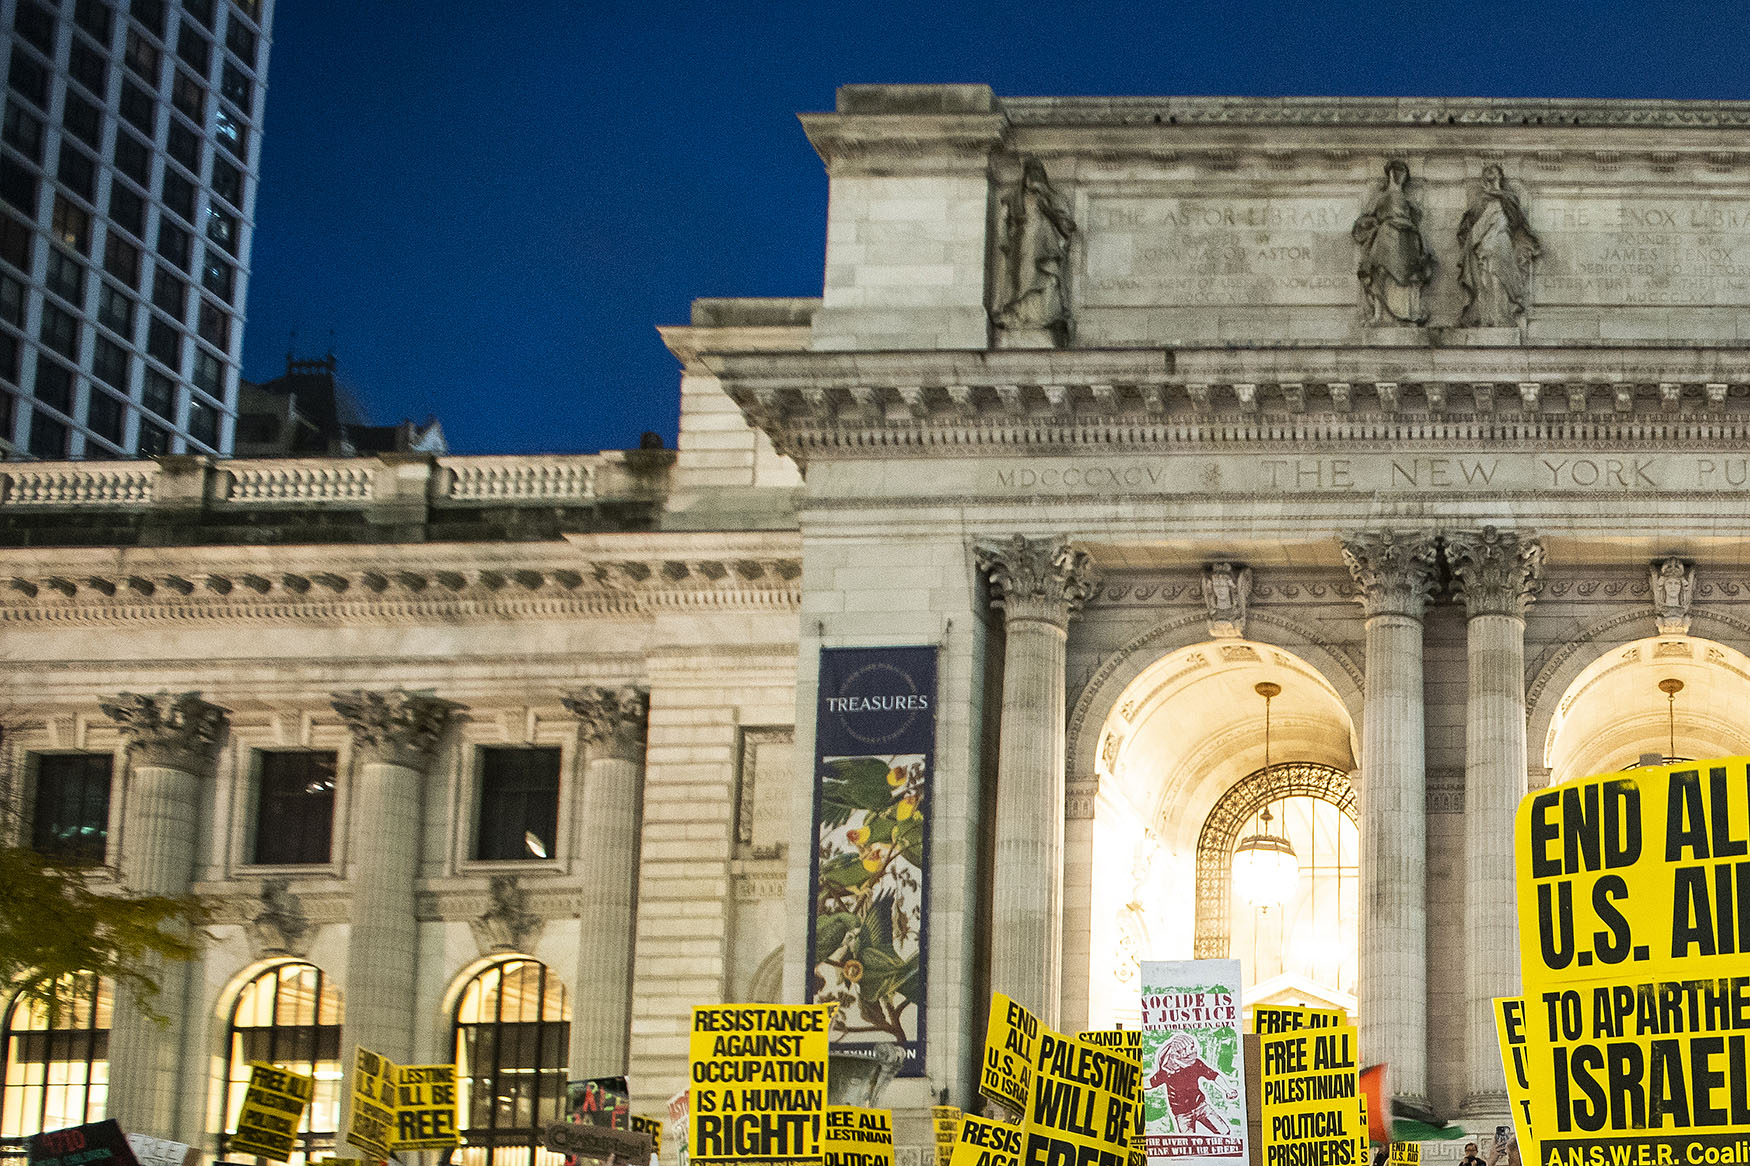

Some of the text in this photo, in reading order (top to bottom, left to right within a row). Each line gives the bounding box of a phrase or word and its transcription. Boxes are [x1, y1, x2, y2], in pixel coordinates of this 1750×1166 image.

[1162, 207, 1343, 226] ASTOR LIBRARY
[1258, 247, 1312, 260] ASTOR
[1600, 248, 1658, 261] JAMES
[997, 467, 1163, 488] MDCCCXCV
[1261, 459, 1355, 488] THE
[1391, 459, 1498, 487] NEW
[1543, 458, 1658, 488] YORK
[826, 695, 928, 712] TREASURES
[1531, 778, 1643, 878] END
[1537, 874, 1650, 970] U.S.
[1214, 992, 1233, 1007] IS
[694, 1009, 824, 1032] RESISTANCE
[1005, 1000, 1038, 1039] END
[1159, 1006, 1237, 1023] JUSTICE
[1163, 1022, 1203, 1032] VIOLENCE
[1215, 1021, 1236, 1030] GAZA
[1542, 989, 1583, 1042] TO
[712, 1035, 805, 1057] AGAINST
[1005, 1029, 1031, 1063] ALL
[1078, 1031, 1124, 1047] STAND
[988, 1047, 1017, 1079] U.S.
[1037, 1034, 1140, 1102] PALESTINE
[1265, 1034, 1355, 1076] FREE ALL
[692, 1060, 825, 1083] OCCUPATION
[985, 1068, 999, 1088] TO
[696, 1089, 823, 1112] IS A HUMAN
[1265, 1073, 1356, 1105] PALESTINIAN
[859, 1115, 890, 1132] ALL
[1033, 1075, 1098, 1138] WILL
[1104, 1096, 1133, 1148] BE
[400, 1109, 456, 1141] REE!
[697, 1113, 820, 1156] RIGHT!
[961, 1120, 1024, 1155] RESIS
[1273, 1110, 1347, 1142] POLITICAL
[1162, 1136, 1224, 1148] RIVER TO THE
